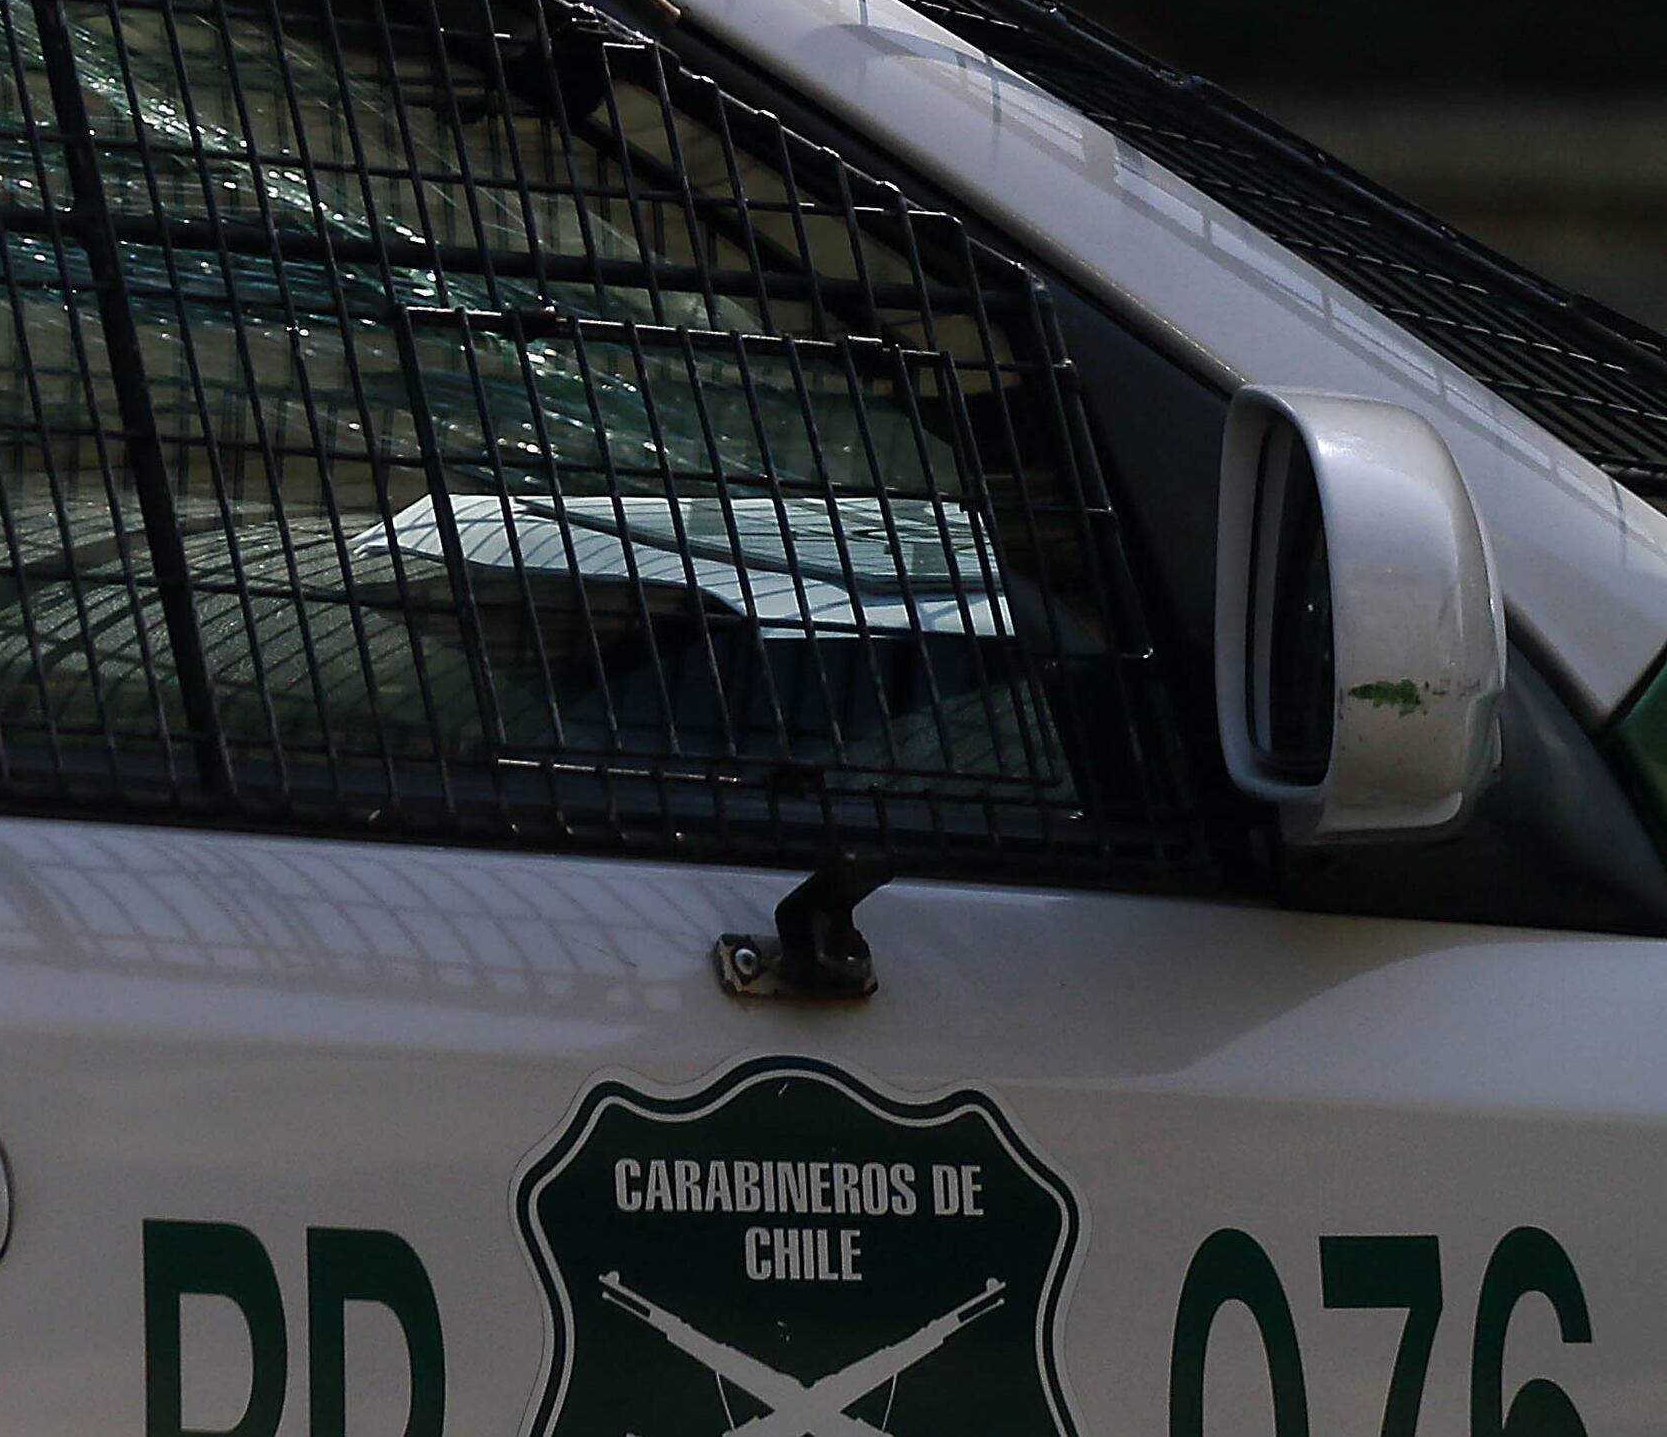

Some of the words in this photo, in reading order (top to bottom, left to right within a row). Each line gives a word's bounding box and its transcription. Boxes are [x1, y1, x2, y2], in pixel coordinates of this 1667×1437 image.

[614, 1158, 918, 1216] CARABINEROS
[931, 1164, 985, 1216] DE
[744, 1226, 863, 1281] CHILE
[1169, 1225, 1593, 1437] 076
